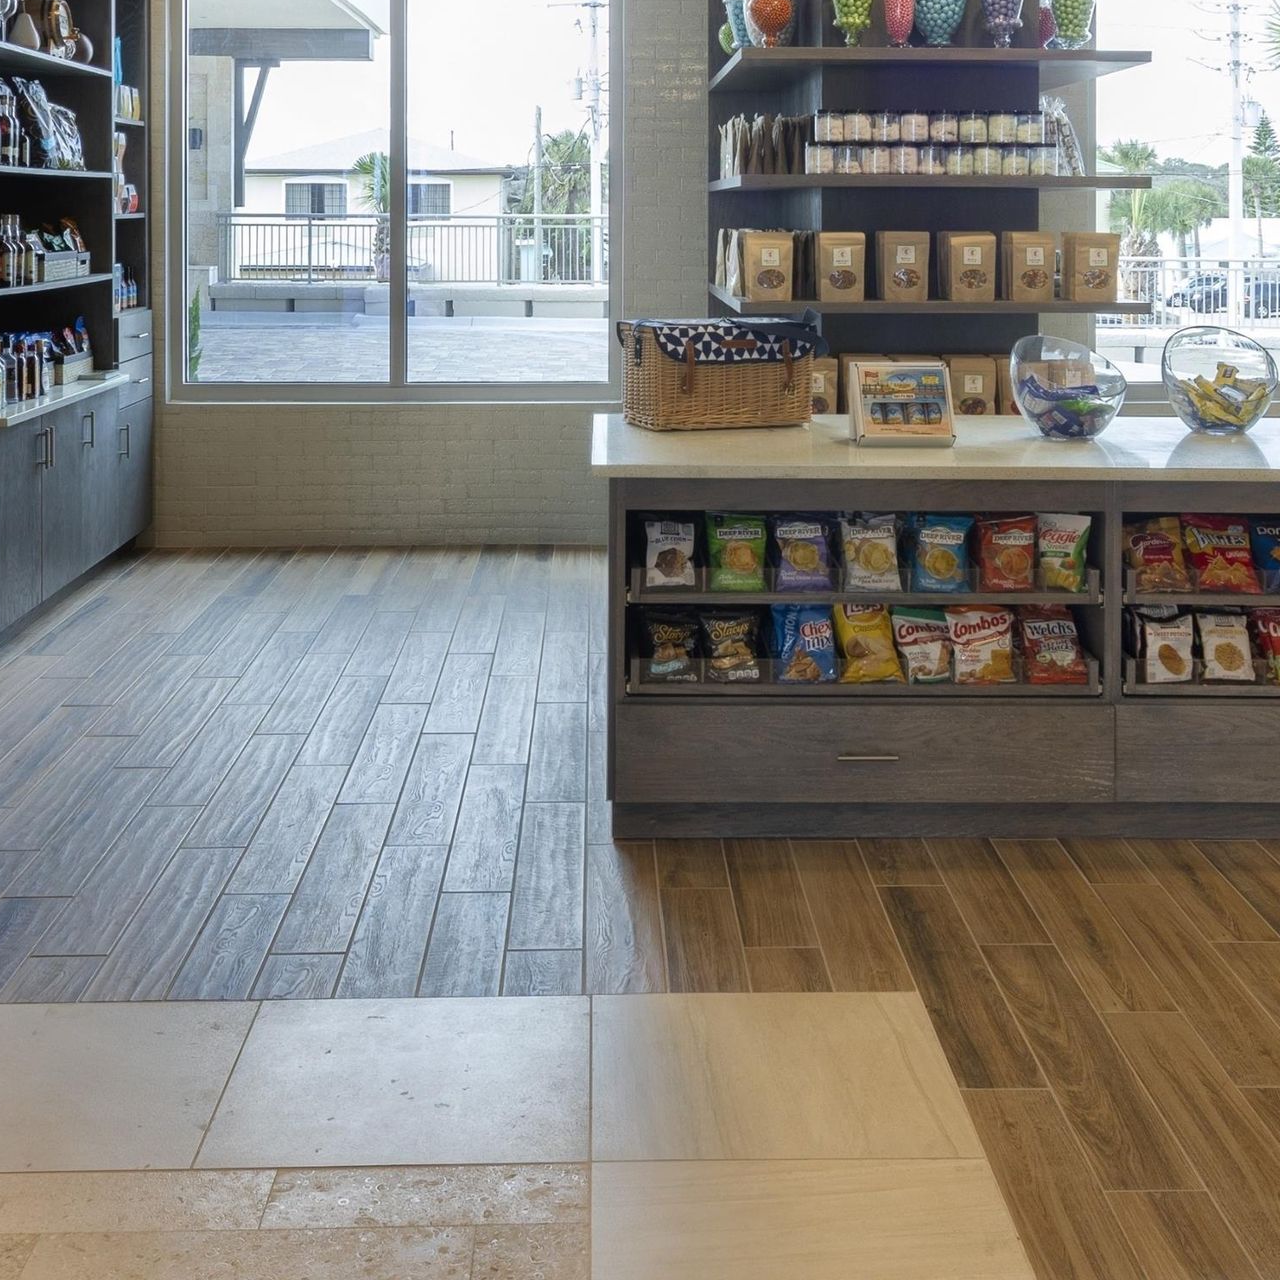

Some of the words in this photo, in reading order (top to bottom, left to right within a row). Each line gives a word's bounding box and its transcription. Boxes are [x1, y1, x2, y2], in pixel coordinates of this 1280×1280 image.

[798, 527, 821, 535] RIVER
[871, 527, 894, 535] RIVER
[801, 620, 832, 637] Chex
[898, 623, 950, 640] Combos
[954, 614, 1008, 639] Combos
[1027, 621, 1074, 636] Welch's
